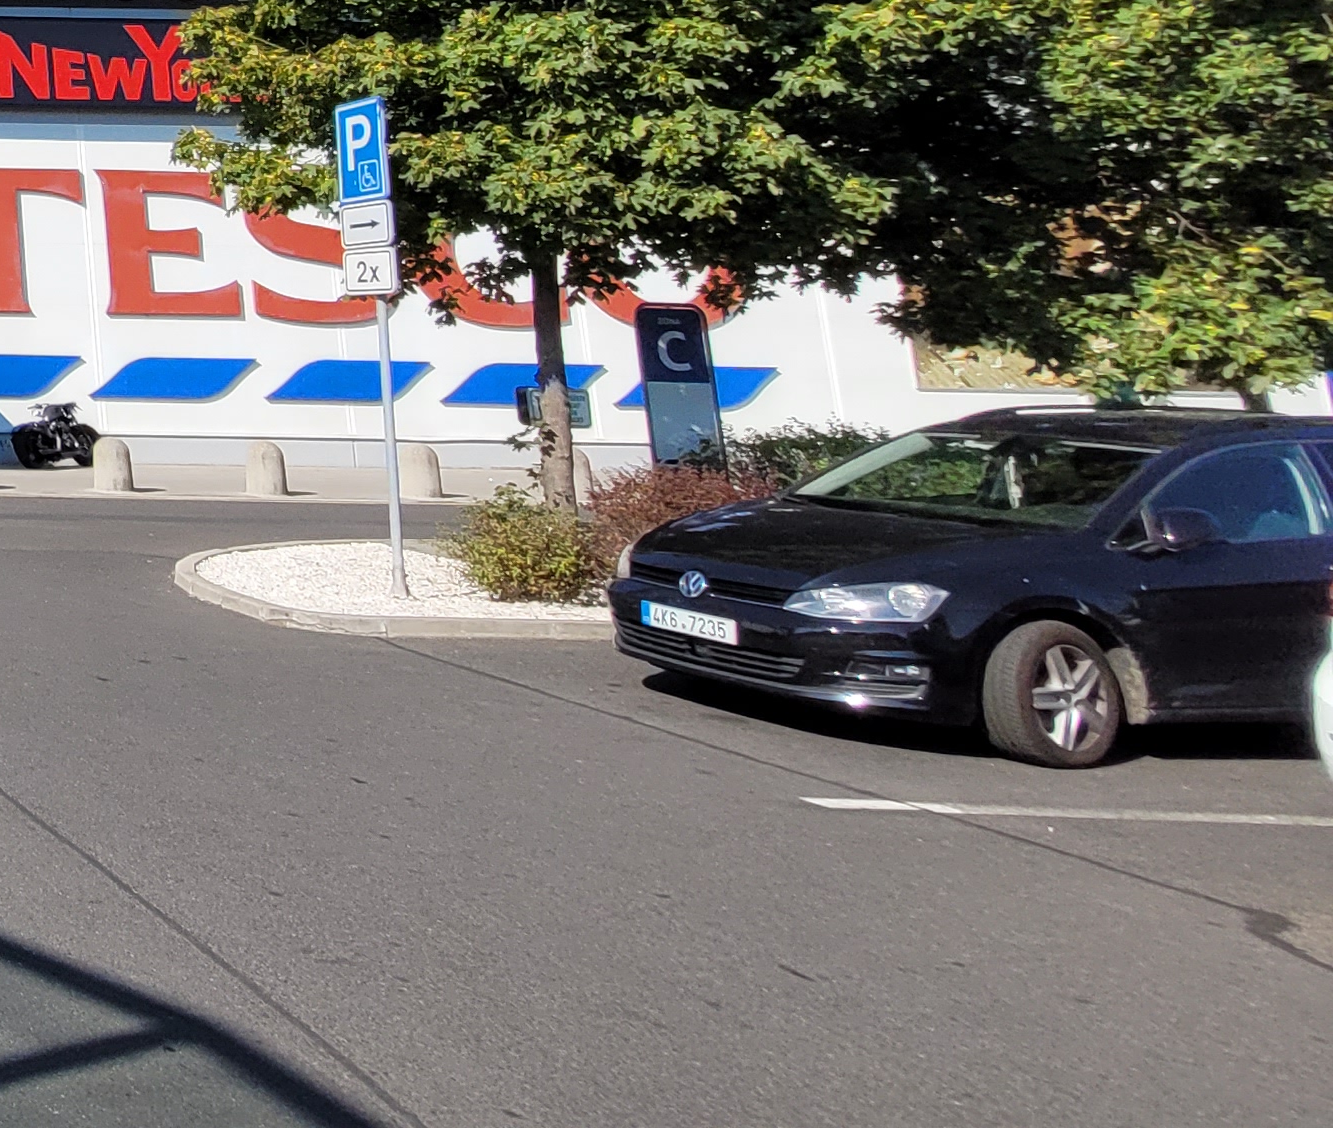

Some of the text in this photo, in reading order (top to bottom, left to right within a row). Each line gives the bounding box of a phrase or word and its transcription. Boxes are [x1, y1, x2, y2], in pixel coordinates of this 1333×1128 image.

[345, 114, 372, 172] P
[356, 260, 381, 283] 2x
[657, 330, 693, 372] C
[653, 607, 727, 639] 4K6 7235
